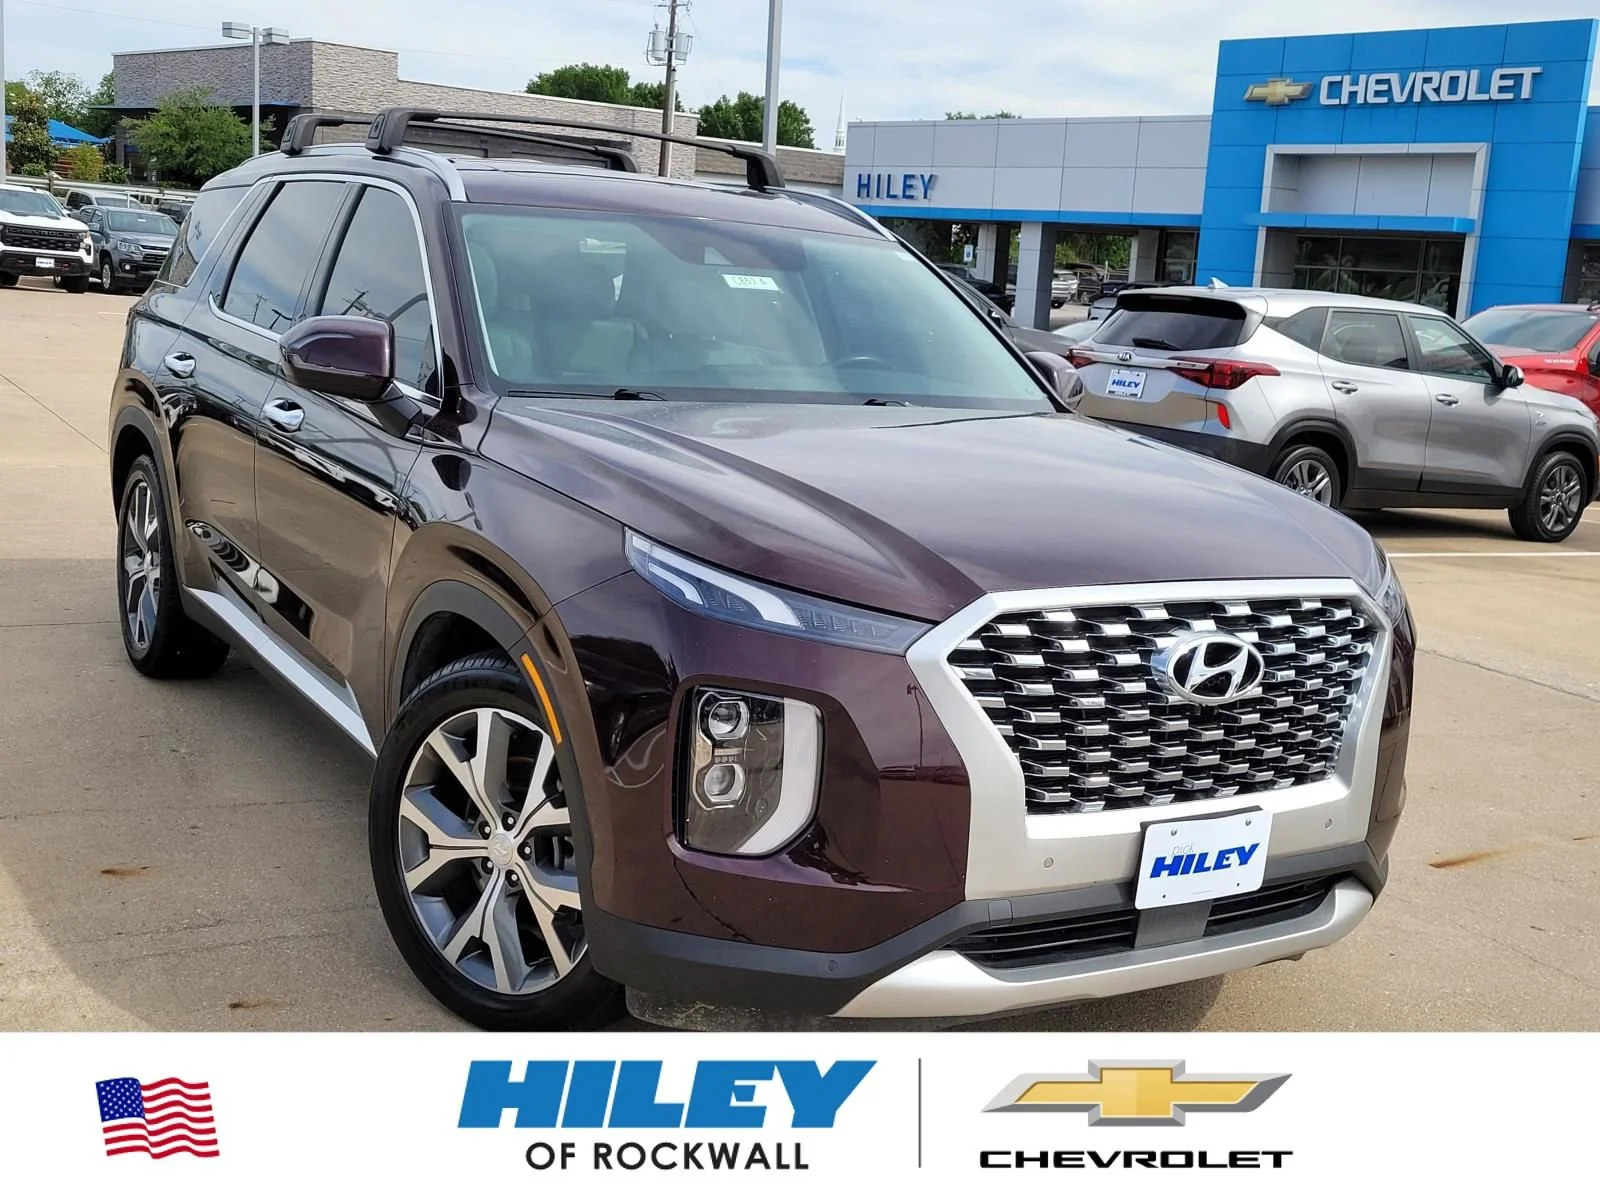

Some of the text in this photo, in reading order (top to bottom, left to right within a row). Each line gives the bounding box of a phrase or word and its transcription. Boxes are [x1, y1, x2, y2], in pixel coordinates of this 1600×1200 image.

[1320, 67, 1543, 105] CHEVROLET
[857, 173, 936, 199] HILEY
[1111, 378, 1141, 388] HILEY
[1149, 842, 1261, 878] HILEY
